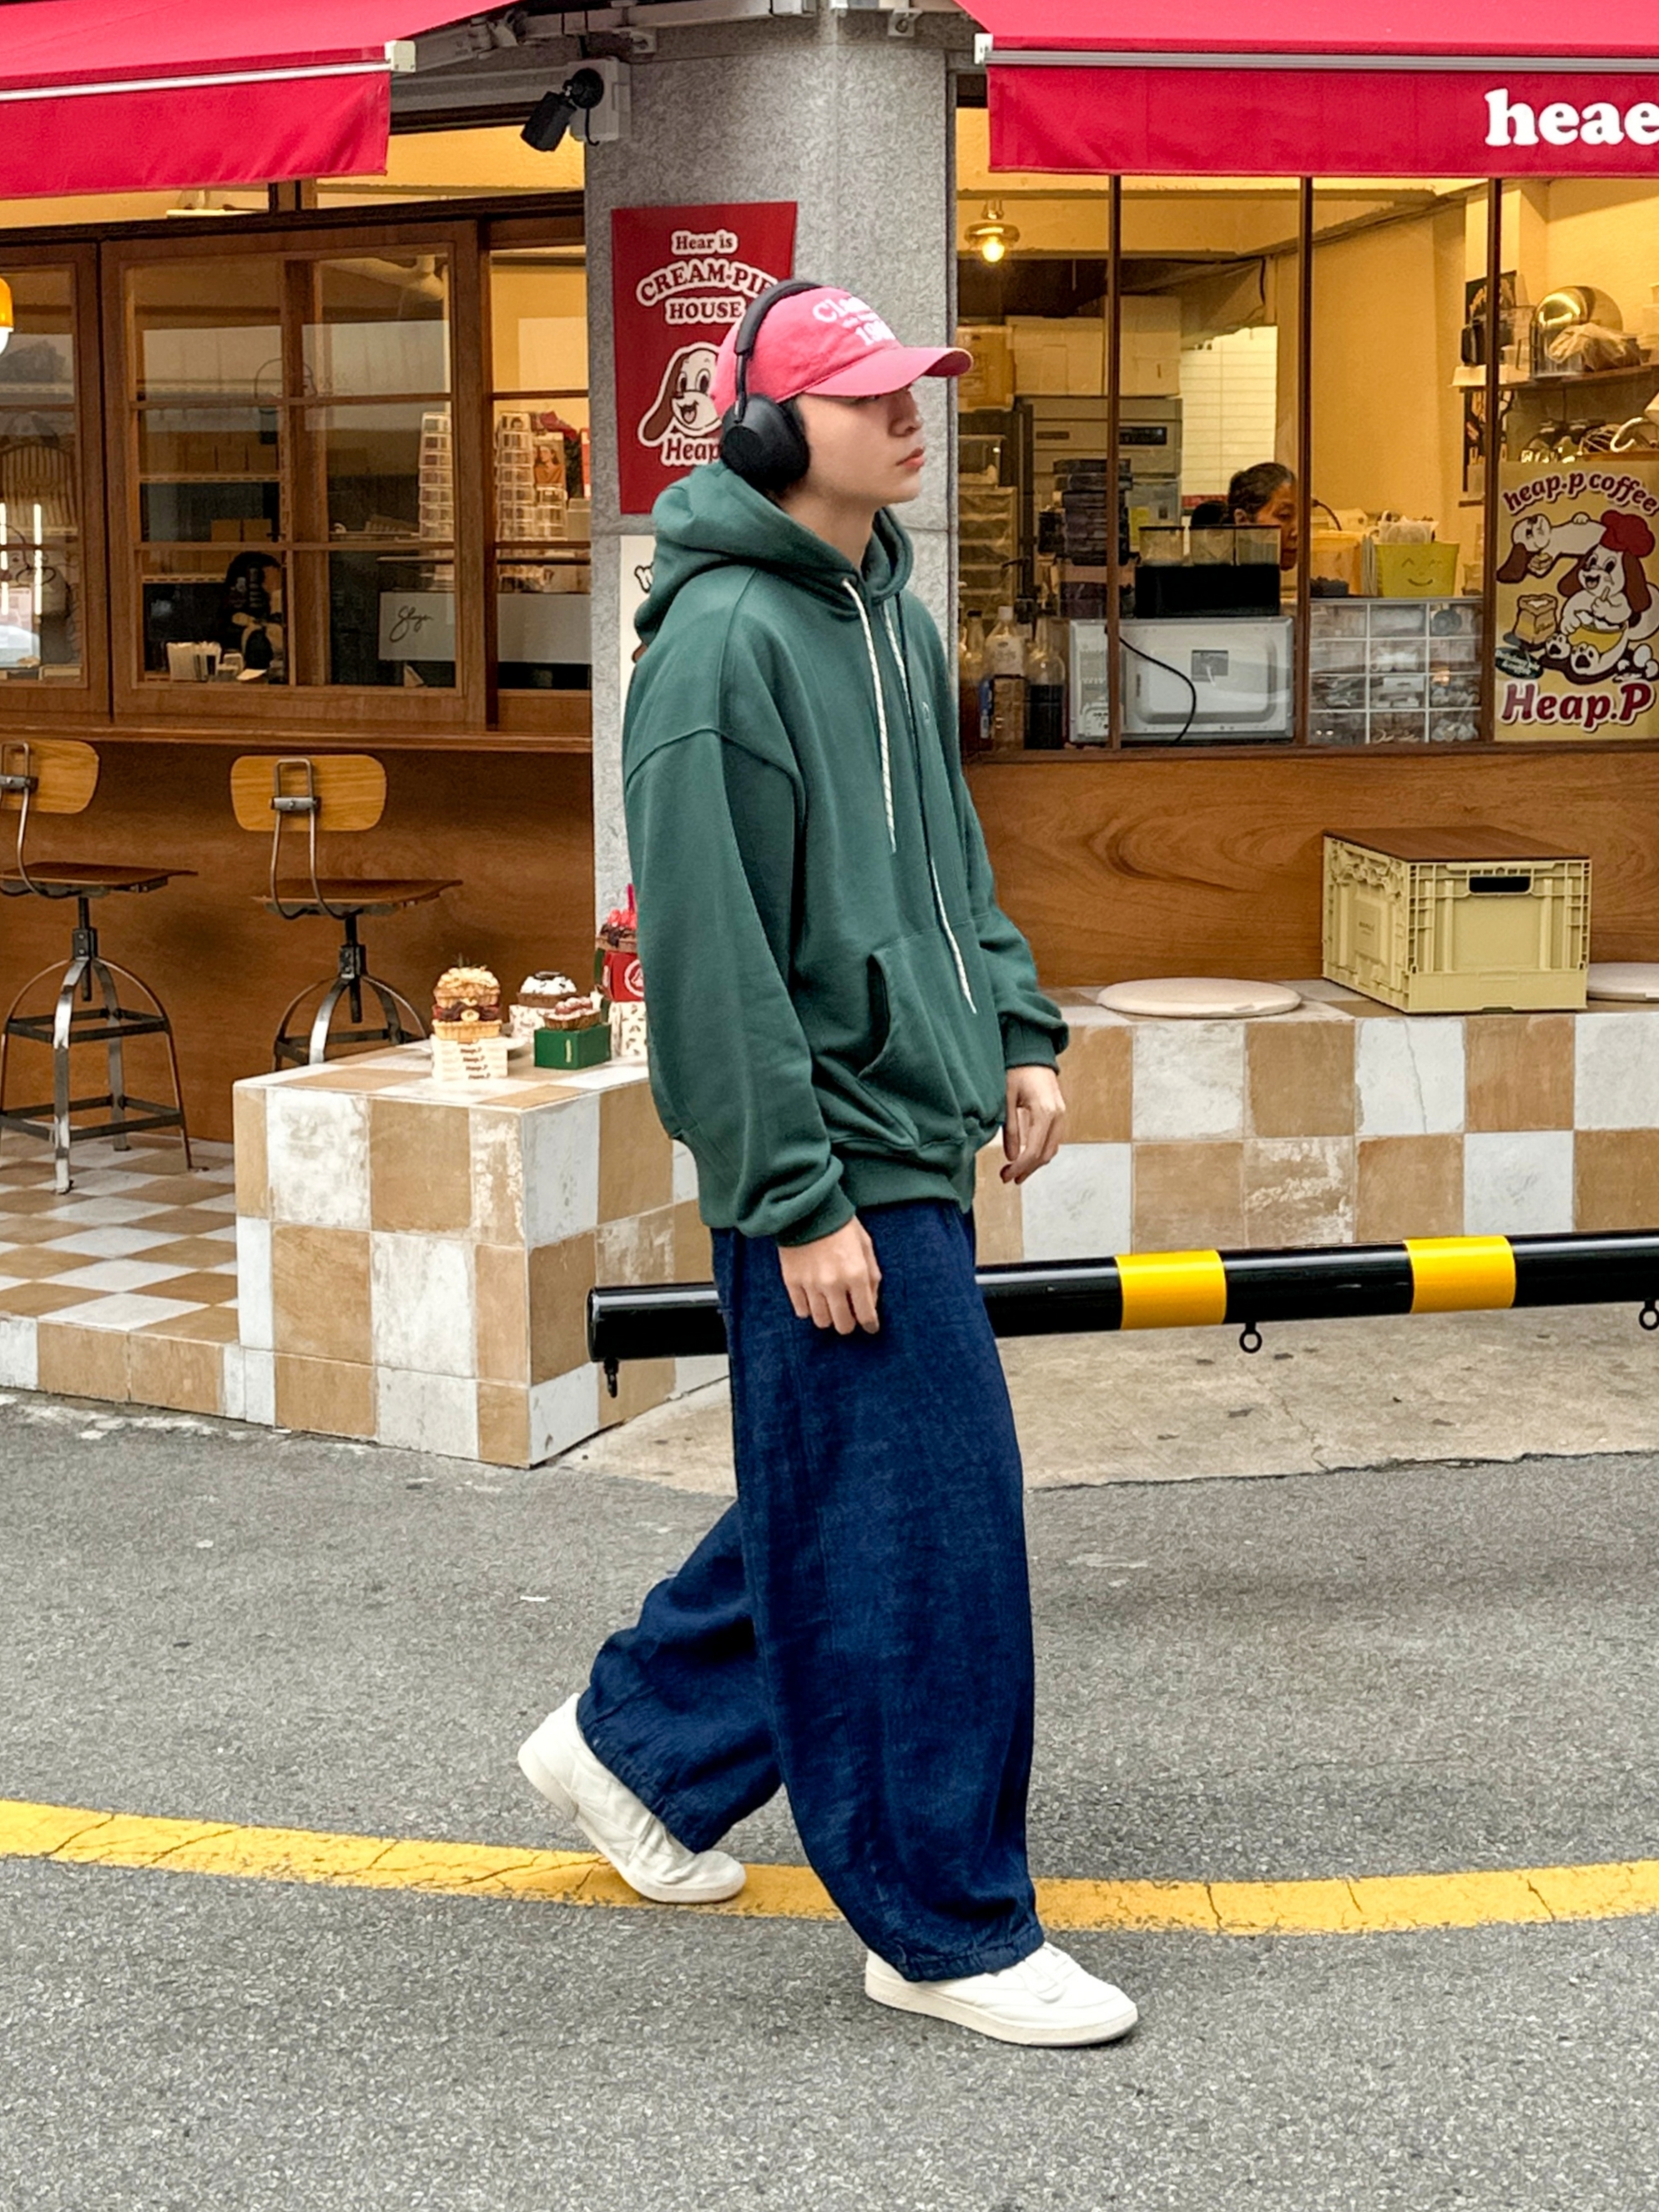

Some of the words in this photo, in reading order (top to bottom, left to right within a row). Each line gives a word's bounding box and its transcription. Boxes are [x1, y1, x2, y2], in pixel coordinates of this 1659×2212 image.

[1484, 88, 1659, 146] heae
[675, 235, 714, 250] Hear
[719, 233, 734, 249] is
[668, 300, 743, 320] HOUSE
[1502, 471, 1586, 511] heap.p
[1588, 472, 1658, 512] coffee
[1501, 683, 1652, 728] Heap.P
